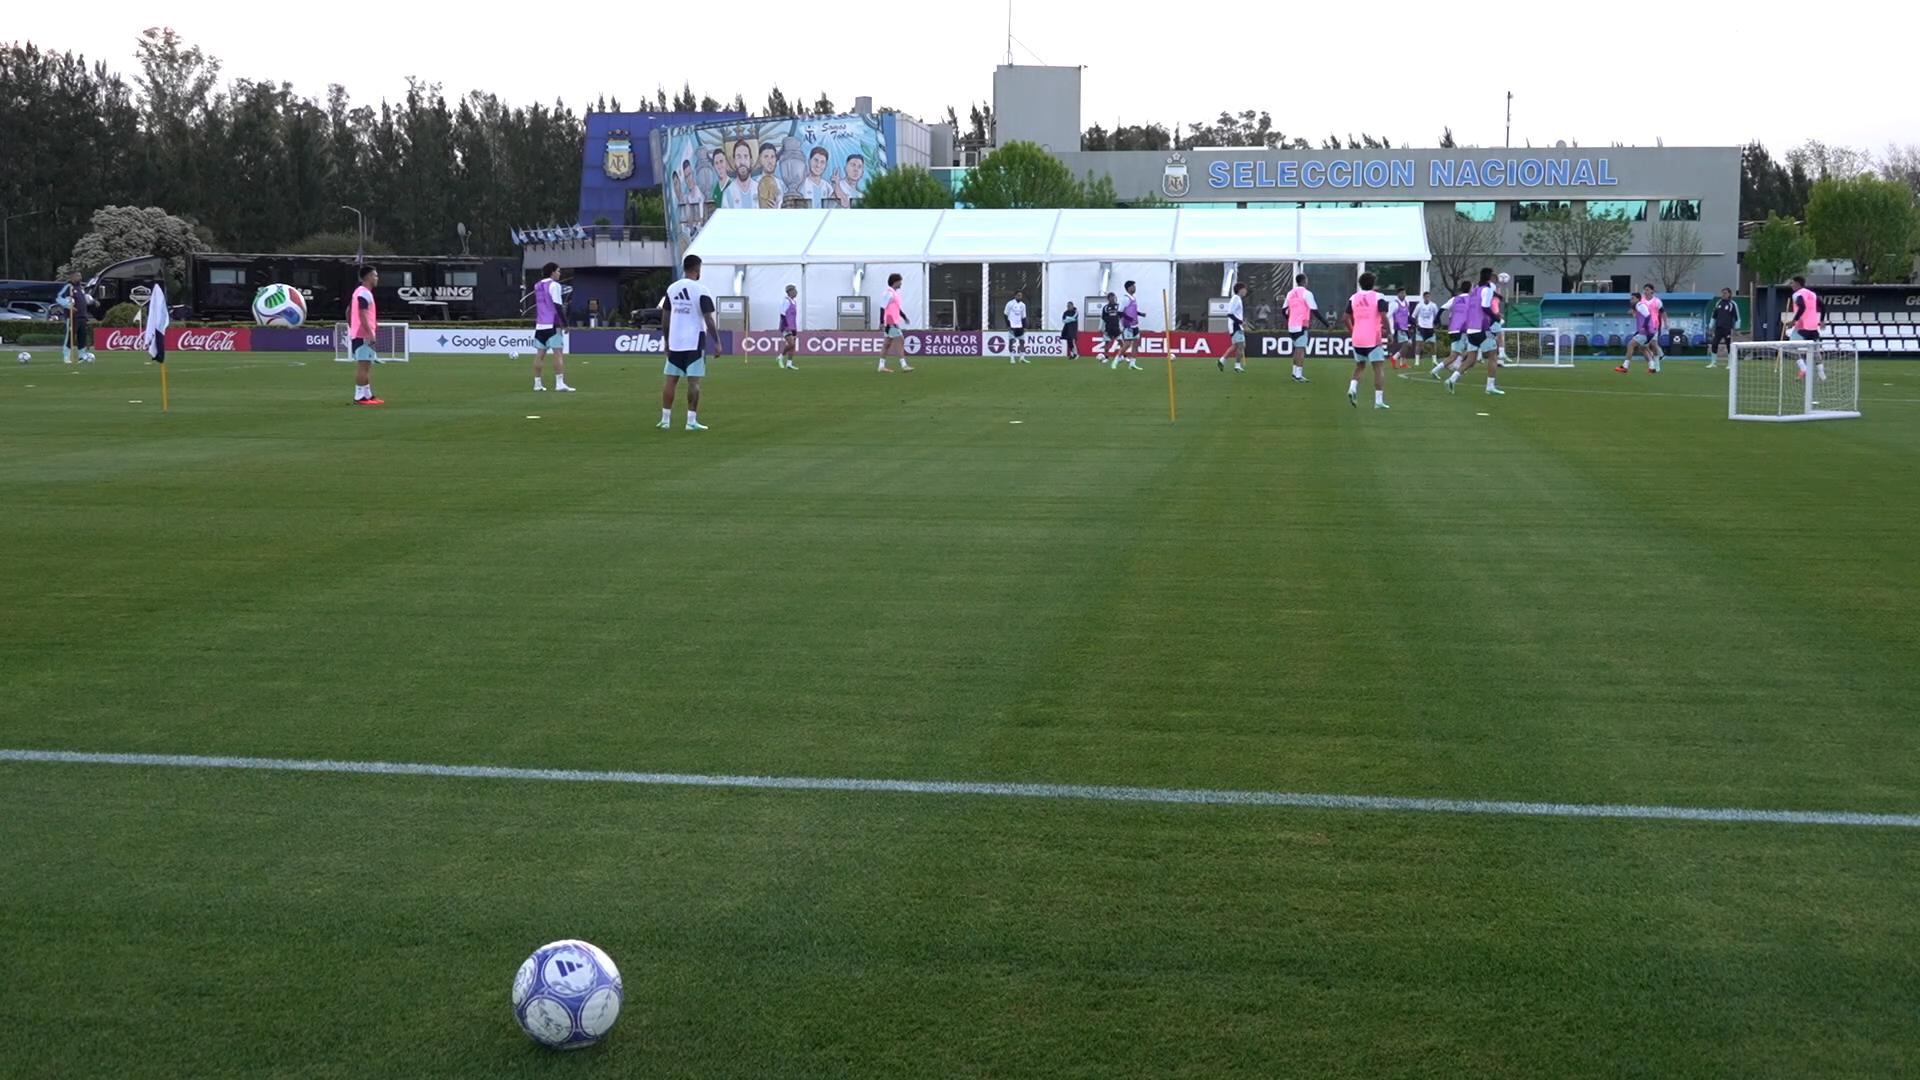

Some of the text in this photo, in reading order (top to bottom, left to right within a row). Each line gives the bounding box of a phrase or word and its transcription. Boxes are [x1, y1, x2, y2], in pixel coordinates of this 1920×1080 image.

[1208, 158, 1617, 189] SELECCION NACIONAL
[1820, 295, 1860, 305] NTECH
[106, 330, 151, 350] Coca-Co
[177, 329, 237, 350] Coca-Cola
[306, 335, 329, 345] BGH
[452, 334, 534, 349] Google Gemi
[615, 334, 665, 352] Gillet
[741, 337, 884, 352] COTI COFFEE
[925, 335, 977, 345] SANCOR
[1012, 335, 1063, 345] NCOR
[1262, 336, 1388, 355] POERA
[925, 345, 978, 355] SEGUROS
